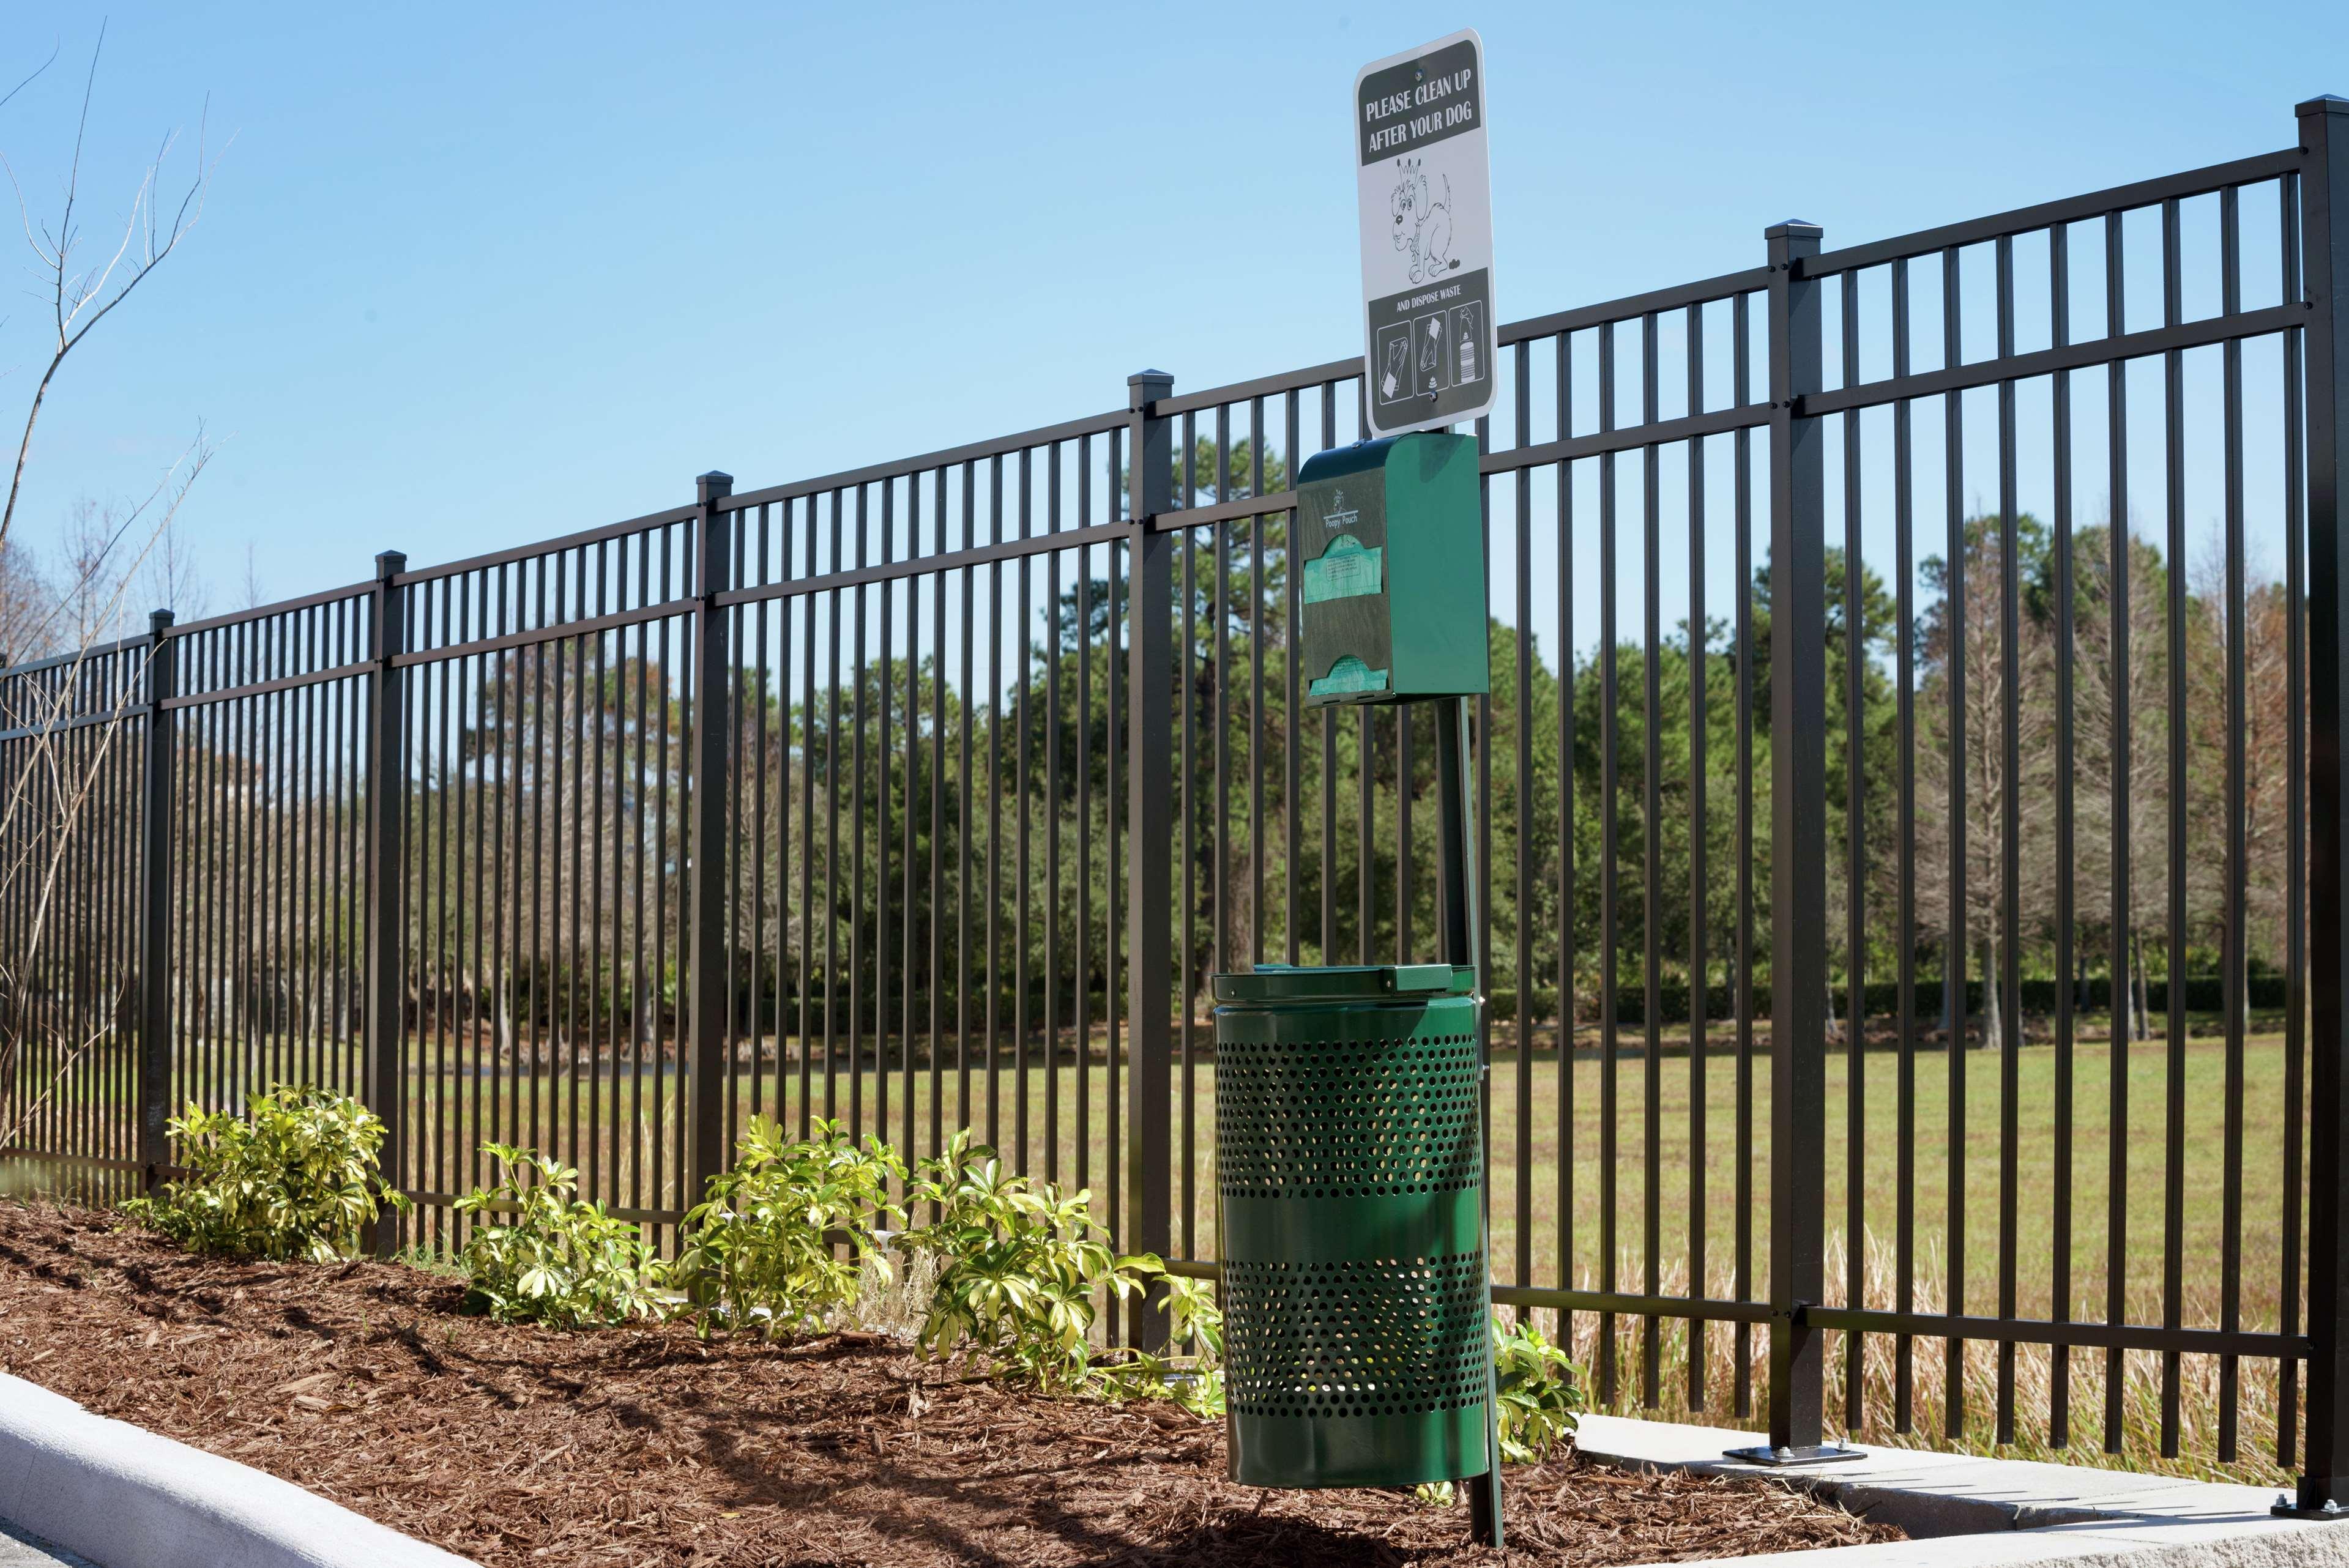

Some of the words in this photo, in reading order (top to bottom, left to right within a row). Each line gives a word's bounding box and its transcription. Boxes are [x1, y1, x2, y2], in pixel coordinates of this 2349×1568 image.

[1366, 90, 1412, 122] PLEASE
[1415, 75, 1451, 105] CLEAN
[1454, 69, 1472, 91] UP
[1369, 124, 1407, 152] AFTER
[1410, 111, 1442, 138] YOUR
[1446, 101, 1472, 127] DOG
[1397, 300, 1410, 312] AND
[1412, 291, 1439, 308] DISPOSE
[1440, 284, 1461, 299] WASTE
[1325, 518, 1341, 529] Poopy
[1342, 514, 1357, 524] Pouch
